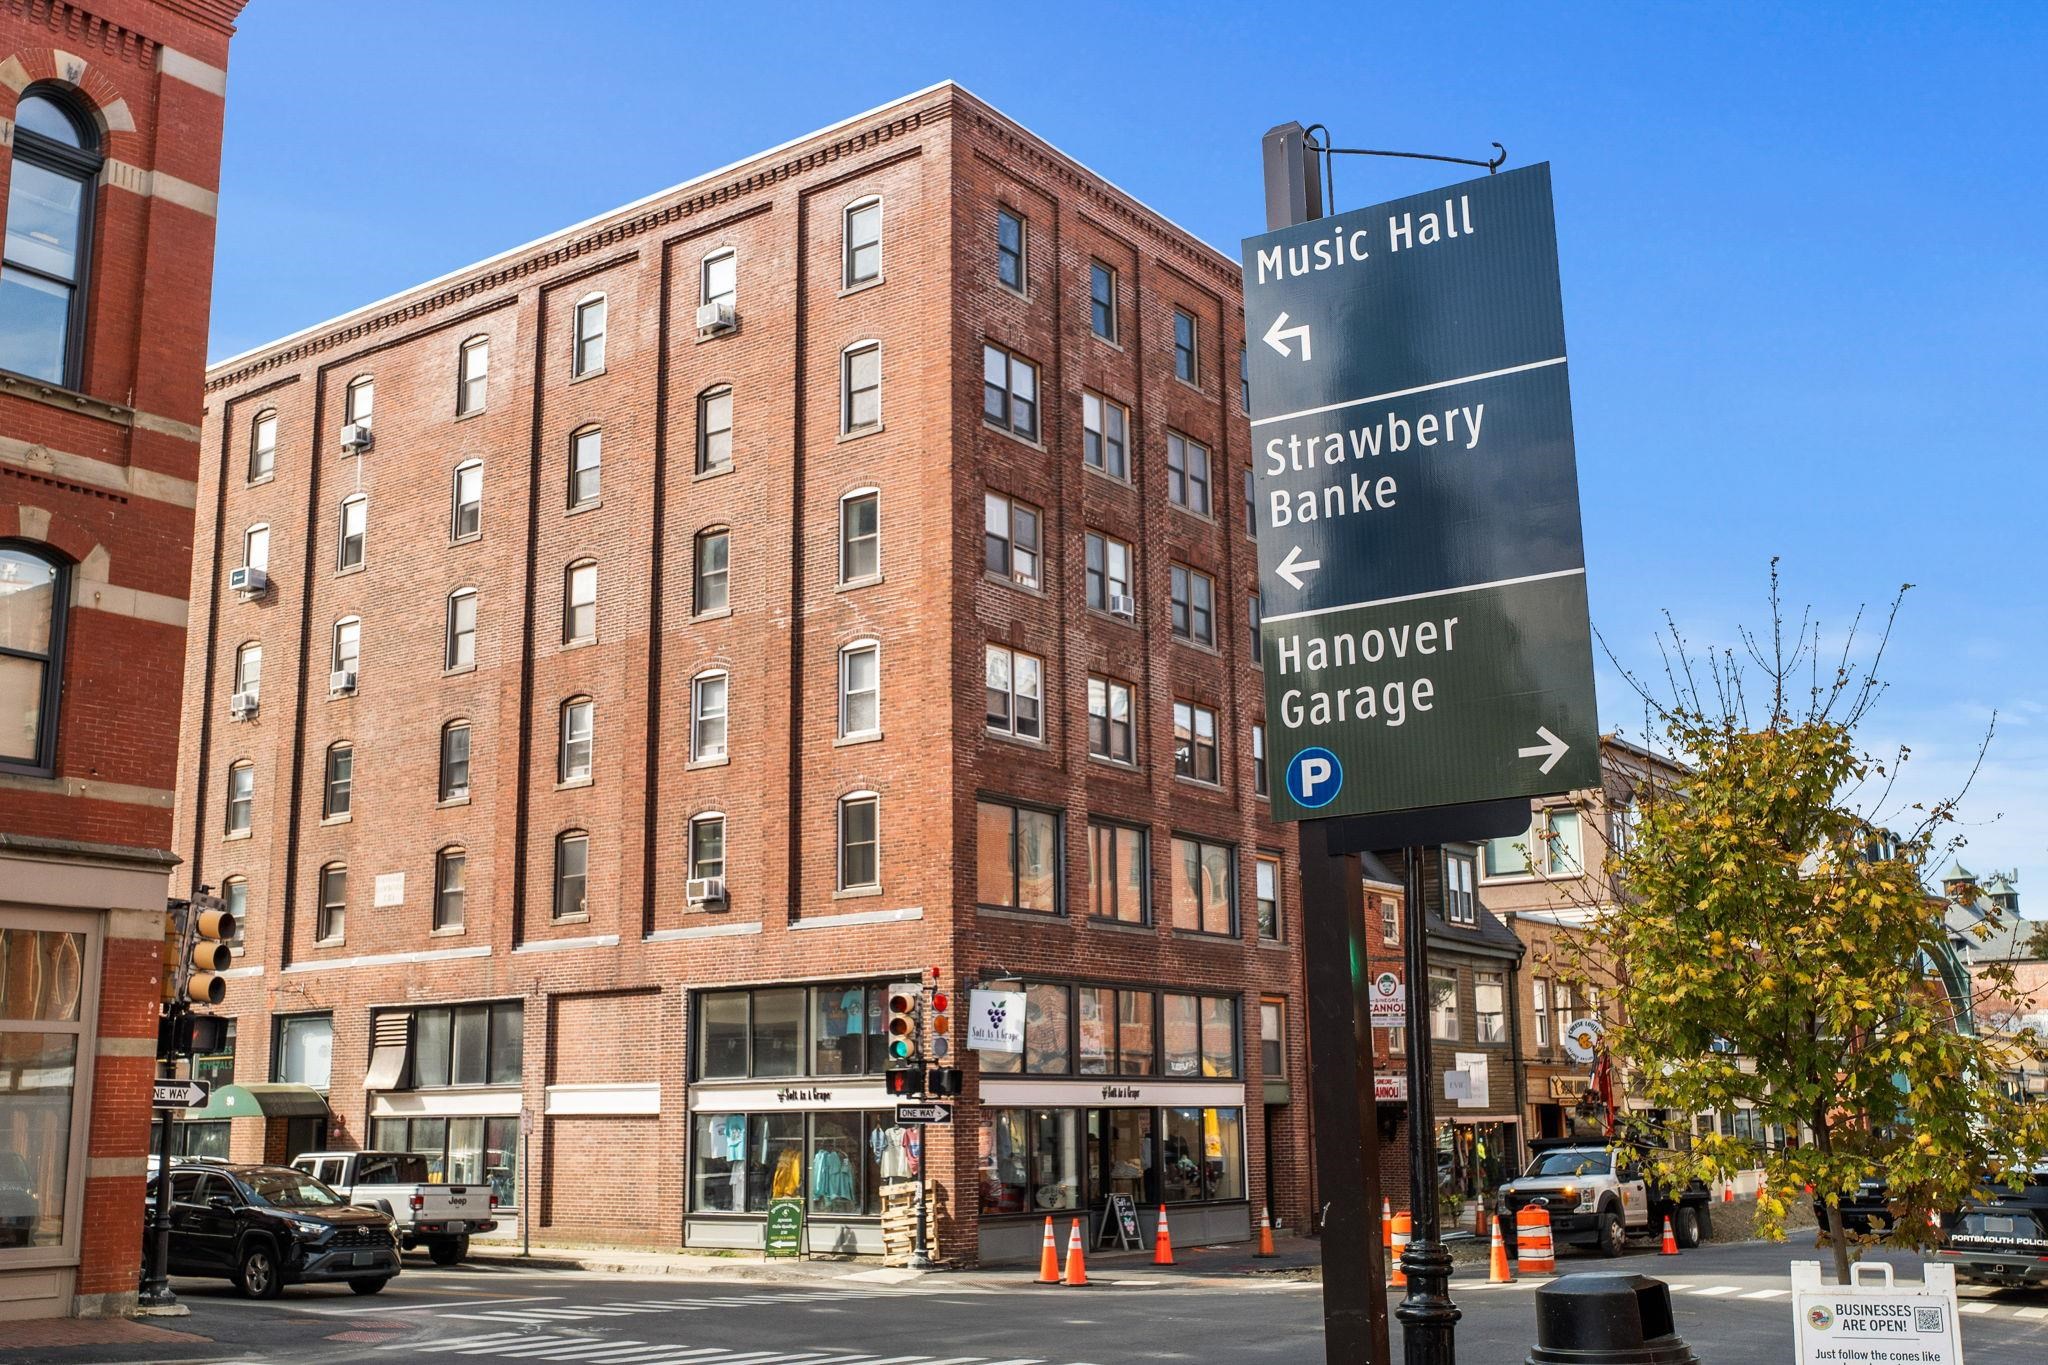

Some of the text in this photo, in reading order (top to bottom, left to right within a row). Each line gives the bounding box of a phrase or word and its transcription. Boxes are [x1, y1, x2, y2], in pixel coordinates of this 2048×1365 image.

[1256, 195, 1475, 285] Music Hall
[1266, 403, 1485, 477] Strawbery
[1270, 473, 1398, 528] Banke
[1277, 616, 1458, 675] Hanover
[1280, 677, 1435, 729] Garage
[1300, 757, 1332, 798] P
[169, 1088, 189, 1100] WAY
[901, 1109, 935, 1118] ONE WAY
[448, 1196, 467, 1206] Jeep
[1951, 1234, 2014, 1244] PORTSMOUTH
[1836, 1304, 1912, 1317] BUSINESSES
[1842, 1319, 1907, 1332] ARE OPEN!
[1815, 1349, 1941, 1362] Just follow the cones like
